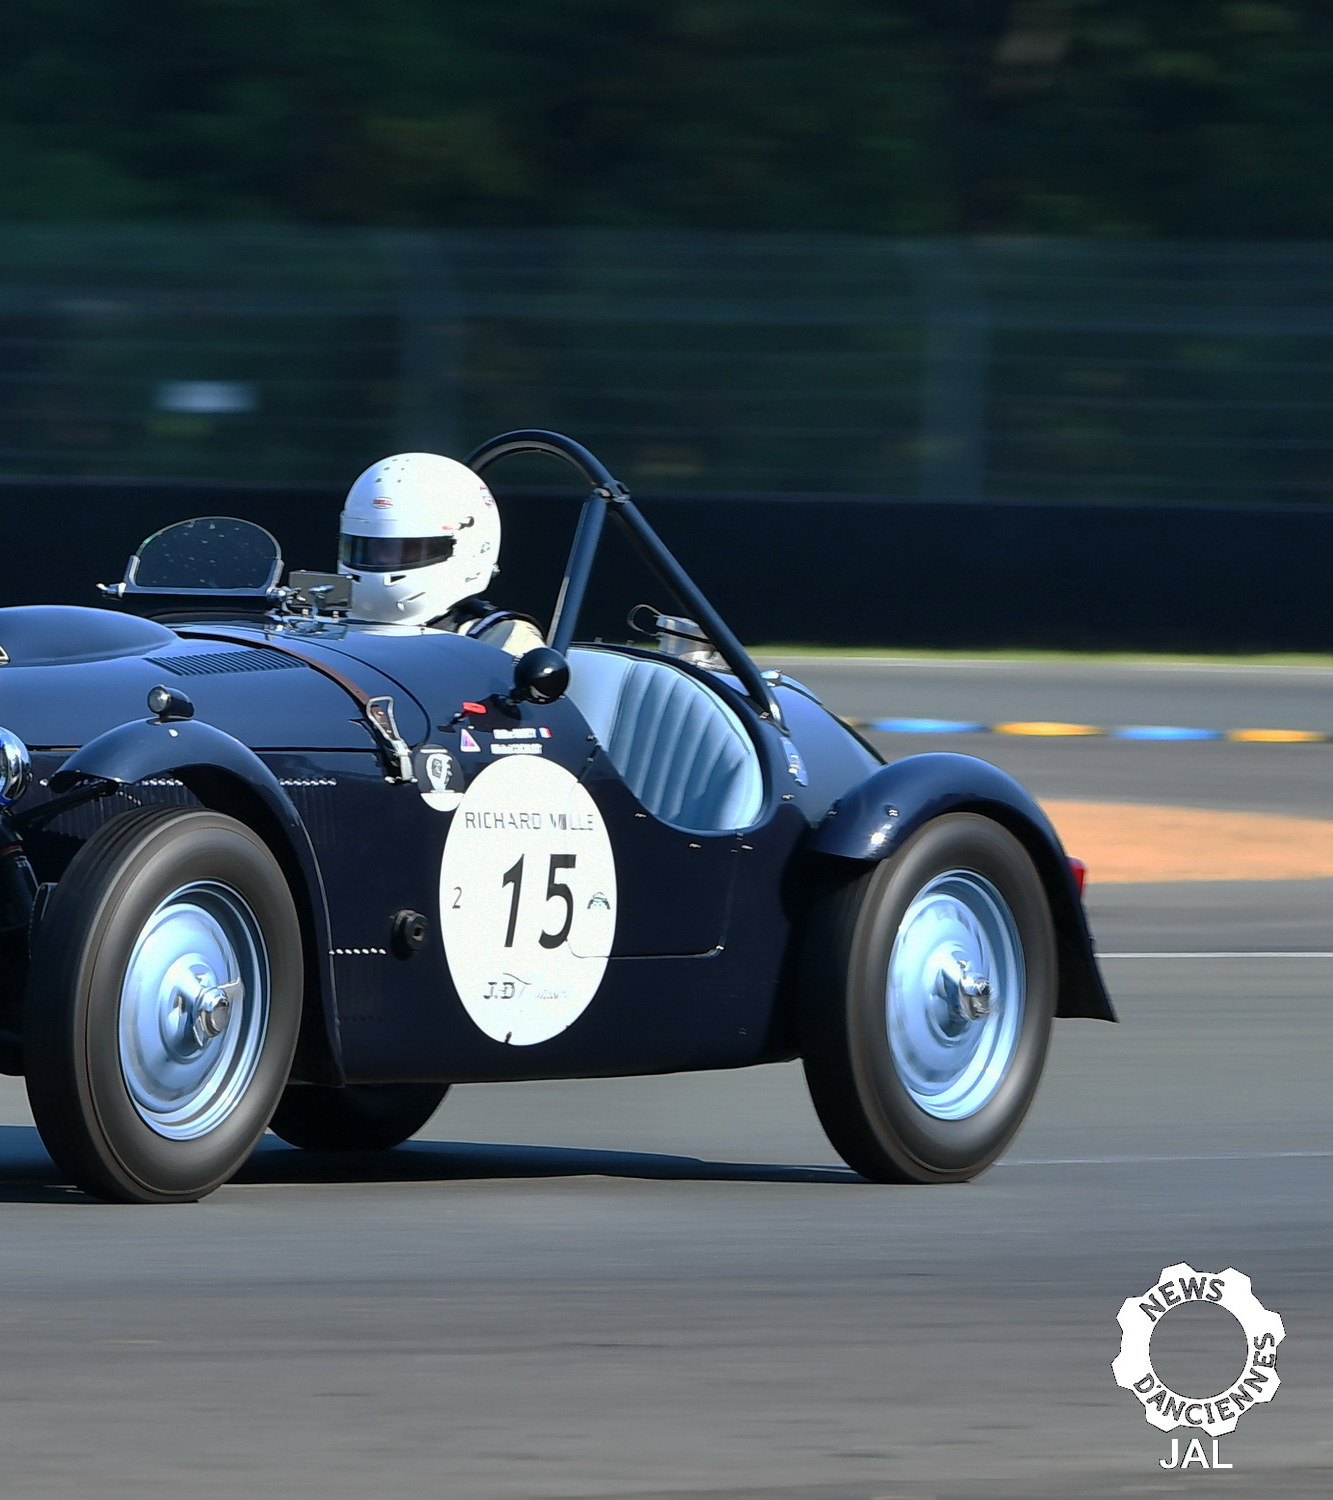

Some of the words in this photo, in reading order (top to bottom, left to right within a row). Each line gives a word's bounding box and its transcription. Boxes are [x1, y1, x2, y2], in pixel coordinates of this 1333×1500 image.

[464, 811, 542, 830] RICHARD
[451, 886, 463, 910] 2
[502, 853, 578, 950] 15
